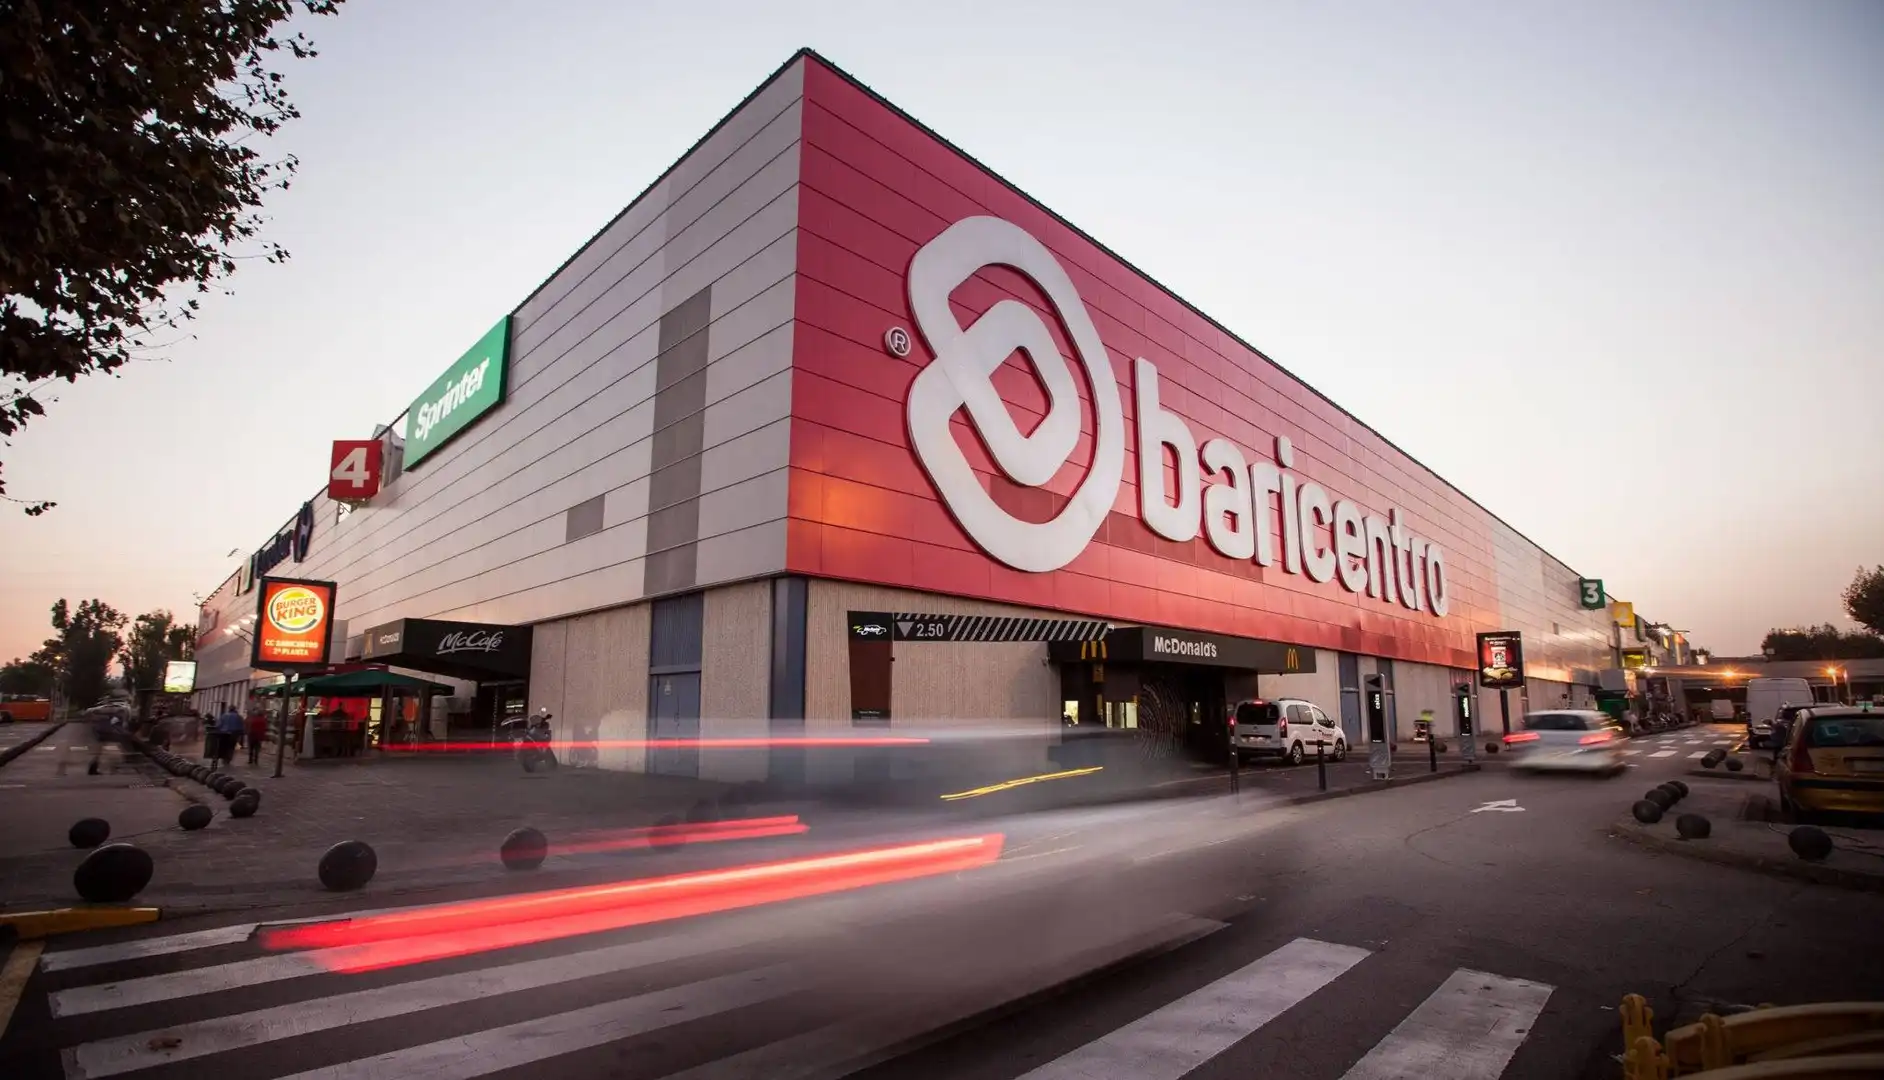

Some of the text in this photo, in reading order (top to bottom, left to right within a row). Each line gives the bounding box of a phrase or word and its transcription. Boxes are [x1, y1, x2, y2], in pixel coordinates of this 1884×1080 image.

[415, 357, 490, 441] Sprinter
[332, 447, 370, 488] 4
[1134, 356, 1449, 618] baricentro
[275, 597, 317, 611] BURGER
[1582, 582, 1600, 604] 3
[276, 605, 317, 621] KING
[916, 623, 944, 637] 2.50
[1154, 636, 1217, 658] McDonald's
